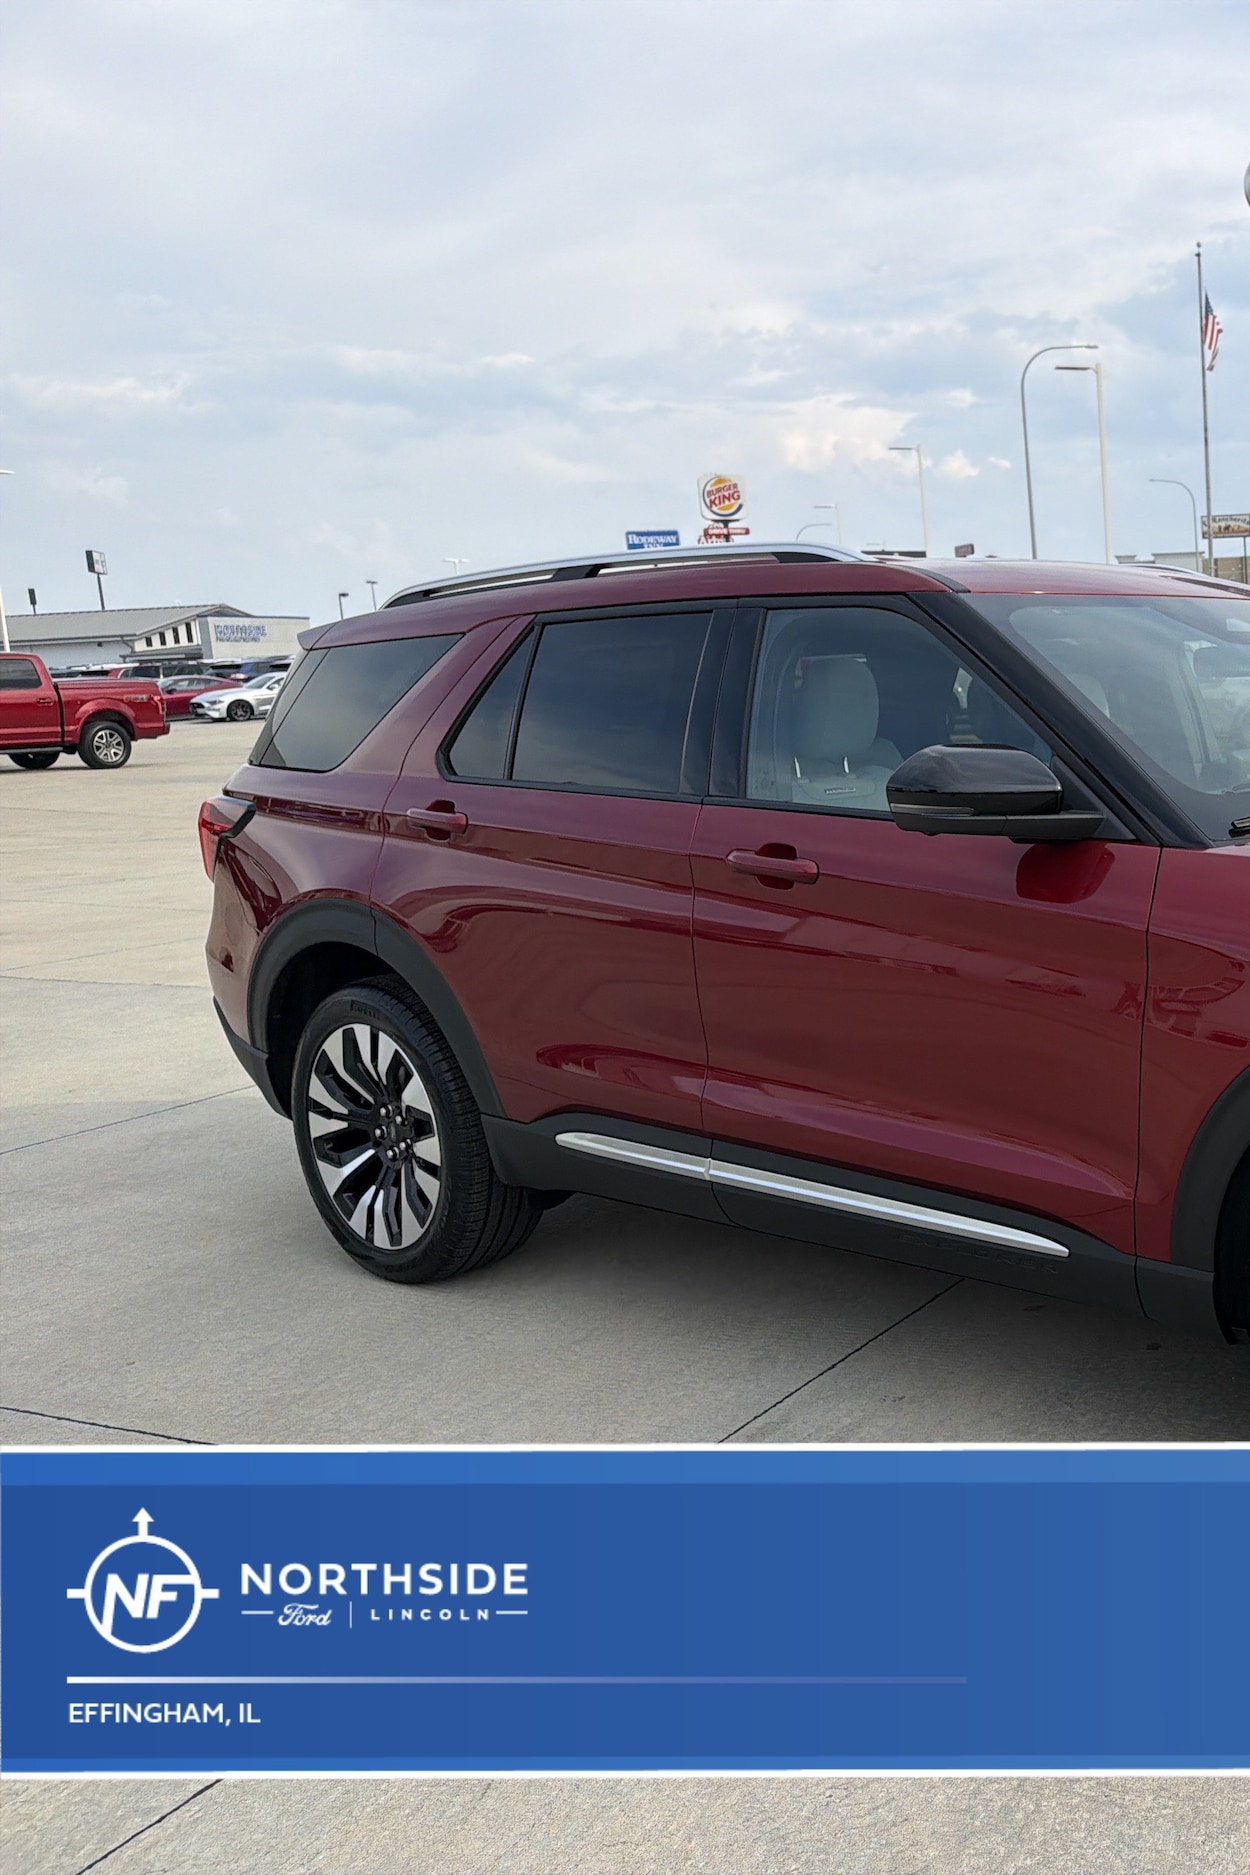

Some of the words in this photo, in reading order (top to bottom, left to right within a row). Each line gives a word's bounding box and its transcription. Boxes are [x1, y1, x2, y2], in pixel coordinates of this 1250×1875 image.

[706, 483, 738, 499] BURGER
[709, 490, 741, 509] KING
[628, 533, 677, 545] RODEWAY
